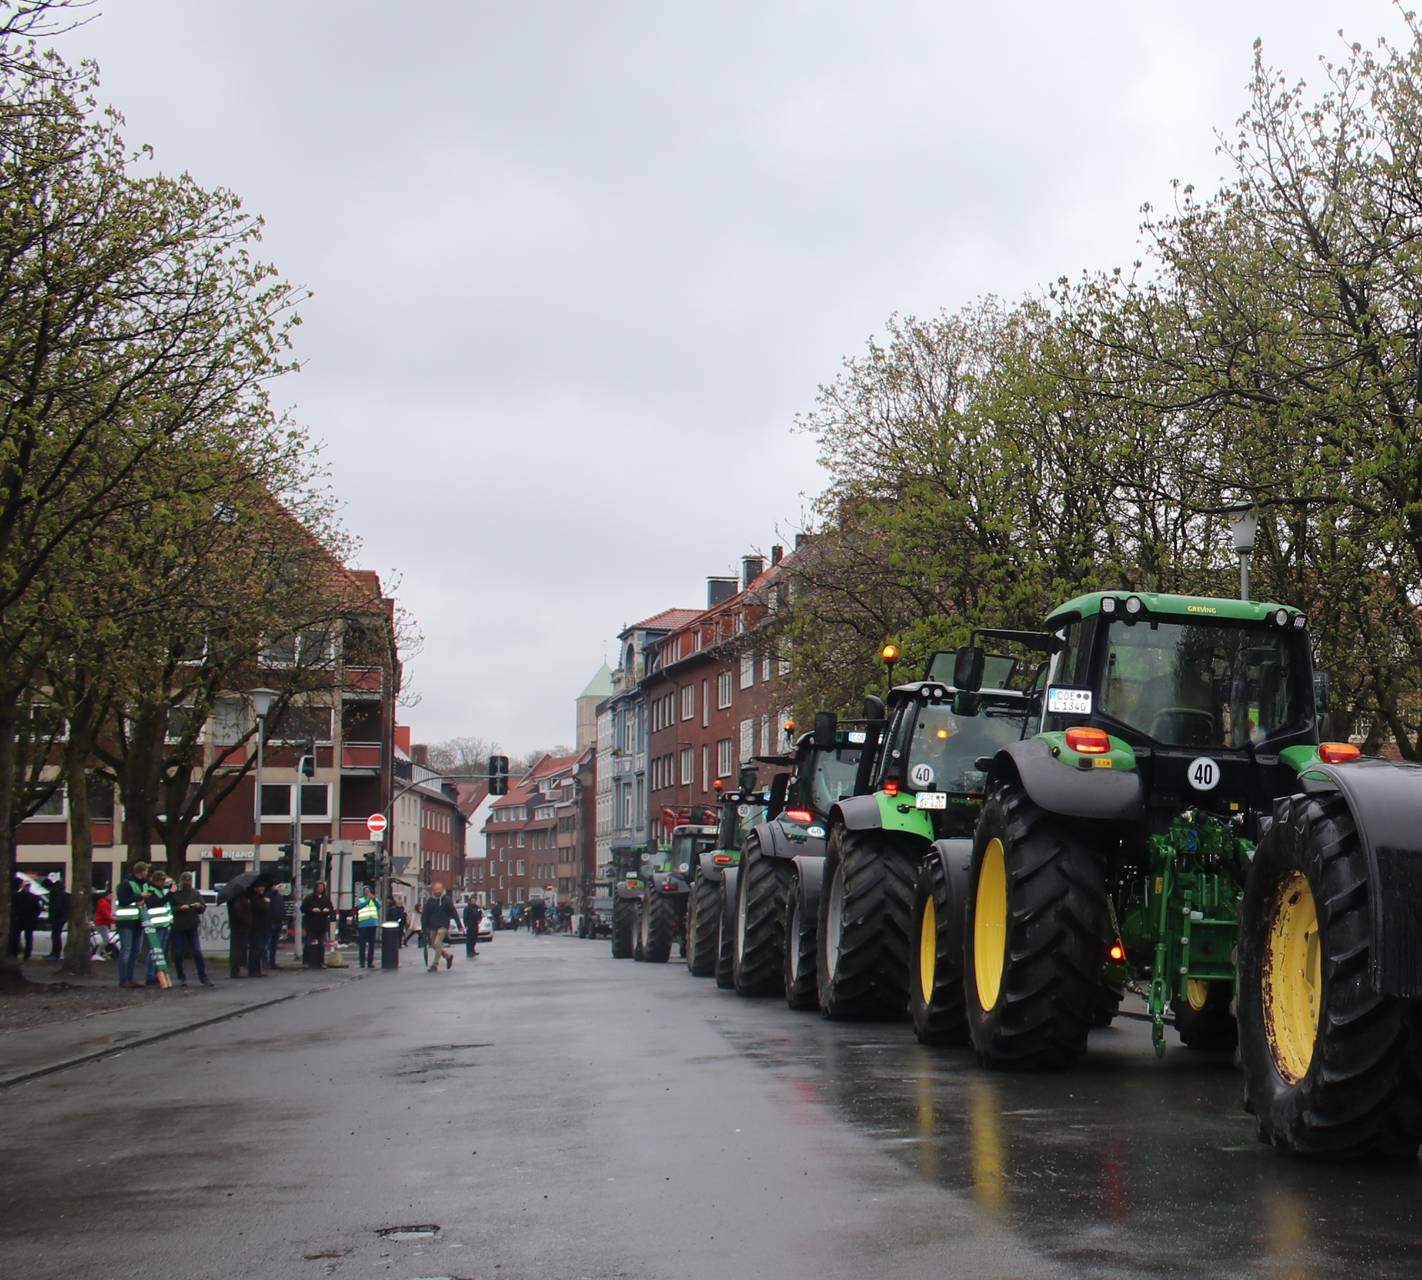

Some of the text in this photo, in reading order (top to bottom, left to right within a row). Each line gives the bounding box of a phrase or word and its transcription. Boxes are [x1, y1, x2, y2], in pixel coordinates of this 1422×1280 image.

[1056, 691, 1076, 701] COE
[1063, 702, 1087, 712] 1340
[916, 768, 930, 782] 40
[1194, 763, 1213, 785] 40
